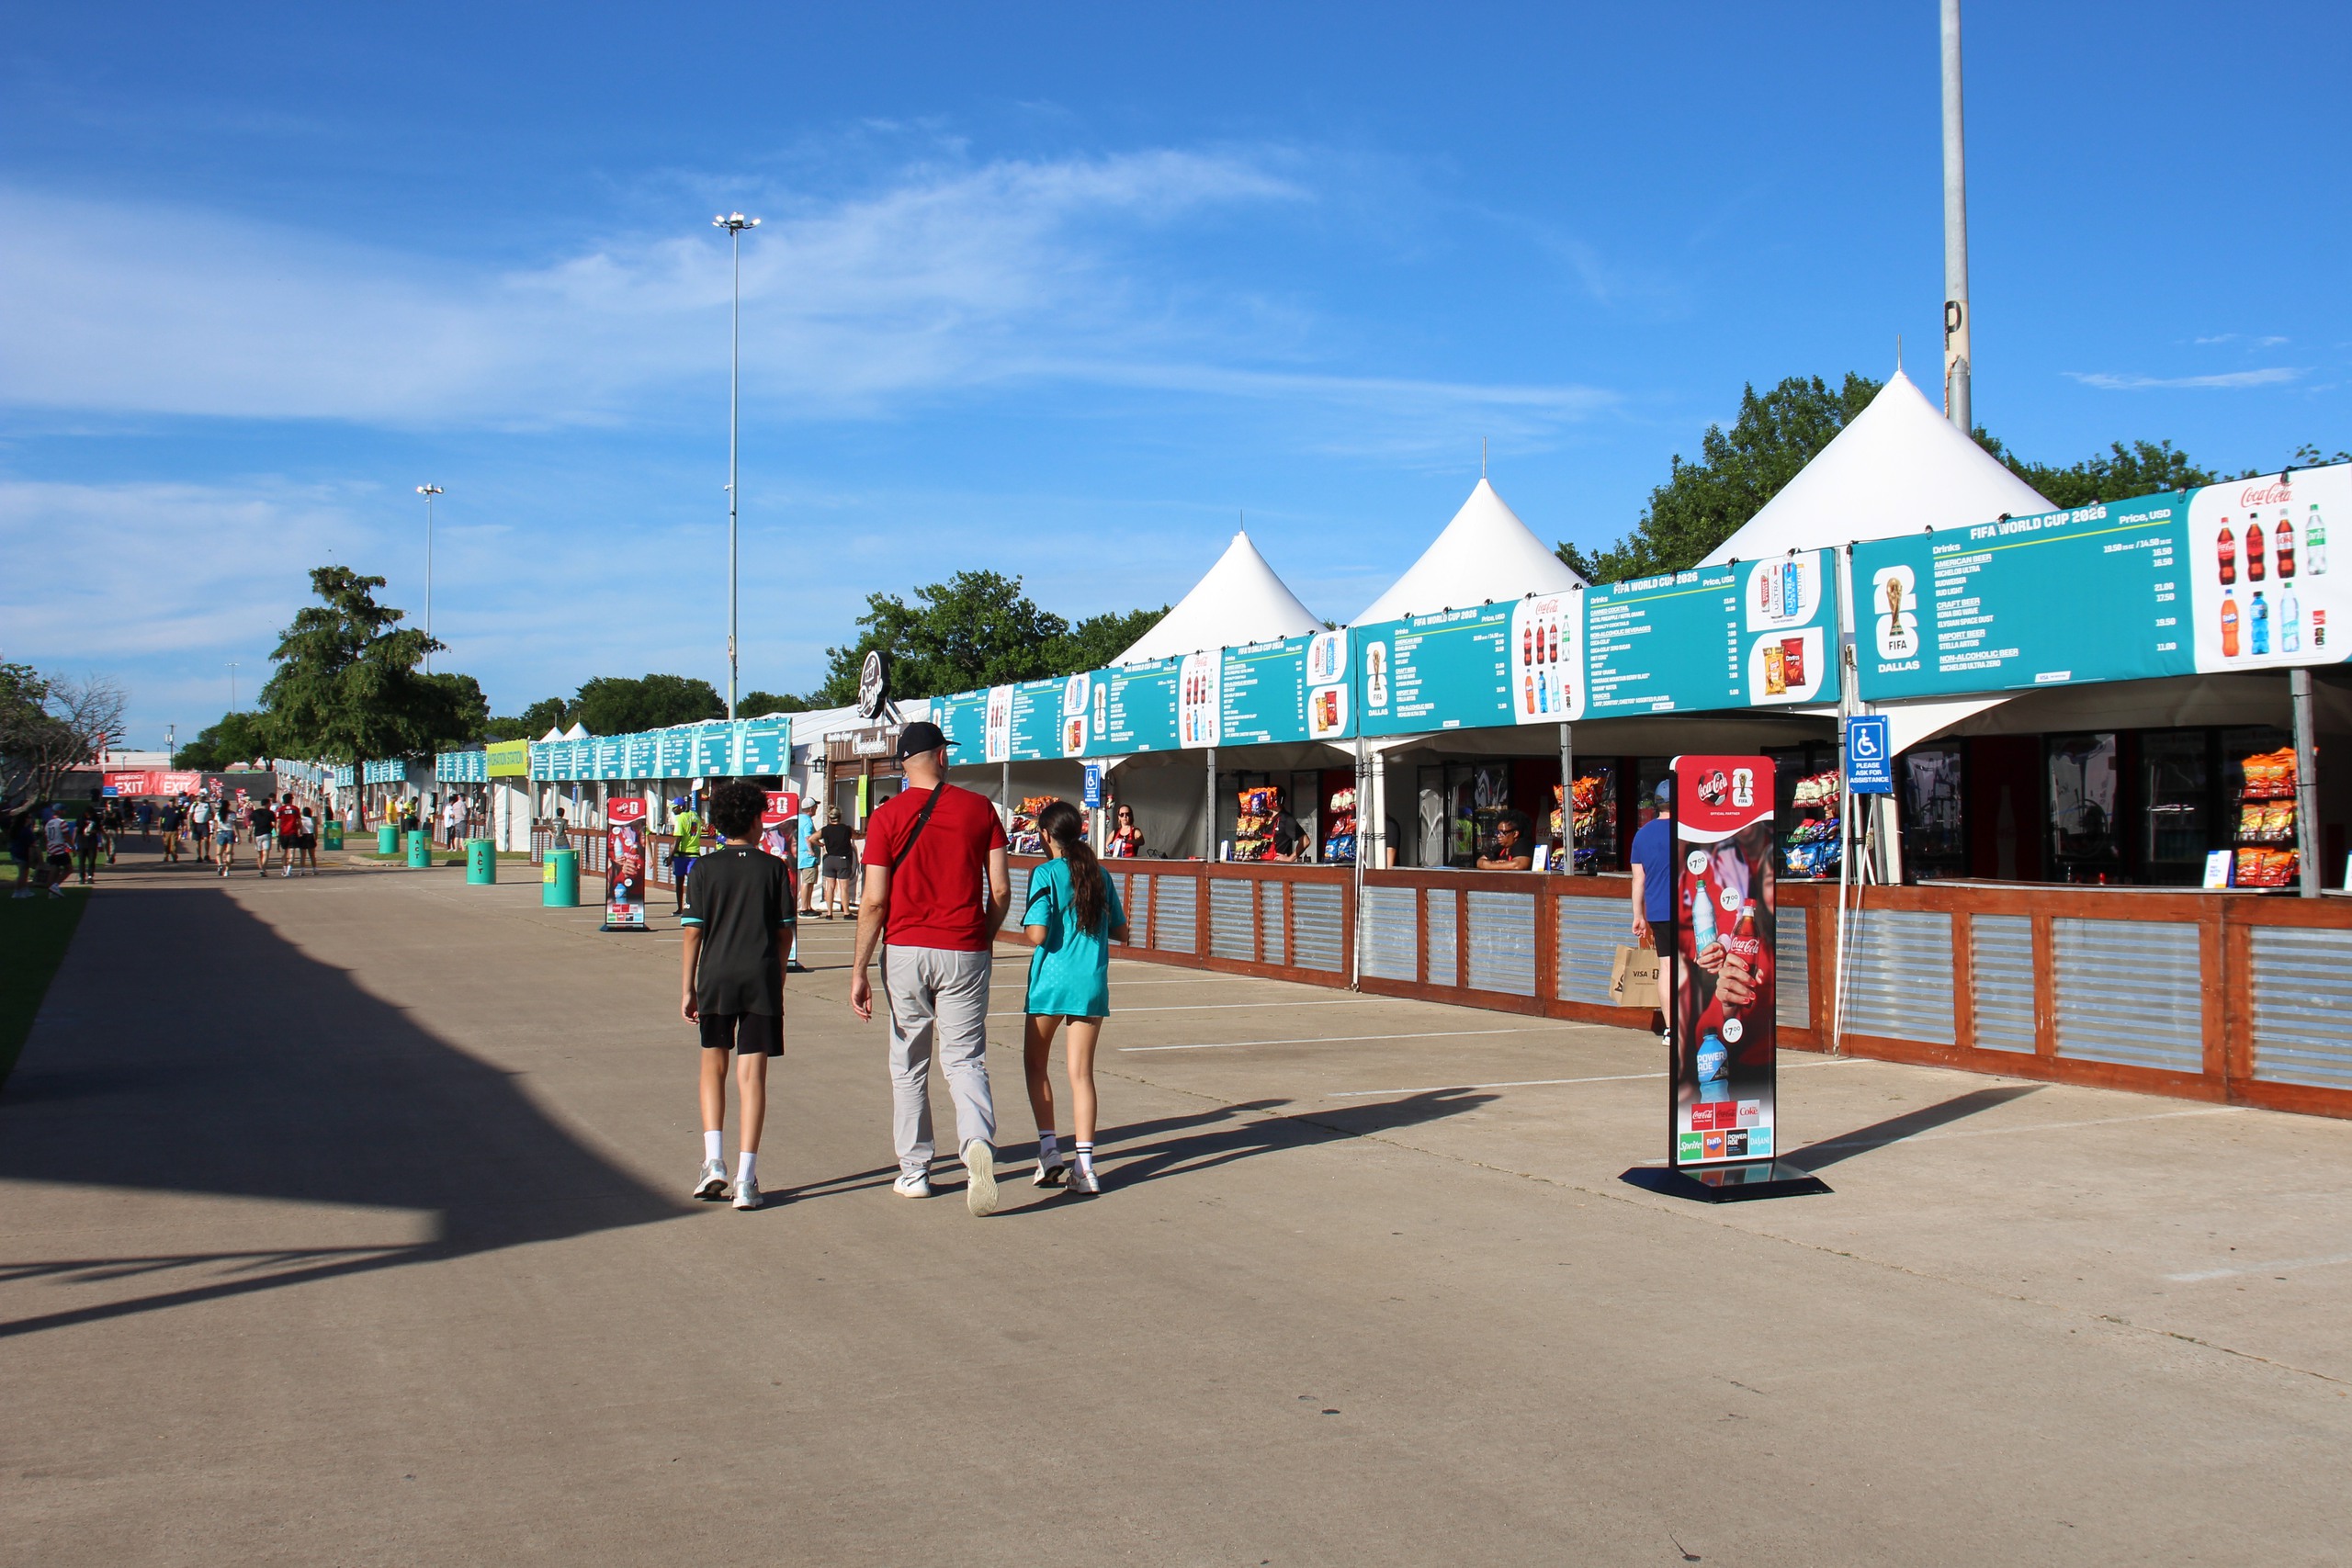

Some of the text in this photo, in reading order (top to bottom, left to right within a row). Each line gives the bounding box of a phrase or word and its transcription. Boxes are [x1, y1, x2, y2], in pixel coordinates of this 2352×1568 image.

[2119, 508, 2171, 525] Price, USD
[1970, 506, 2108, 540] FIFA WORLD CUP 2026
[1933, 543, 1961, 555] Drinks
[2153, 547, 2173, 557] 16.50
[1934, 553, 1992, 569] AMERICAN BEER
[1613, 583, 1630, 595] FIFA
[1631, 578, 1658, 592] WORLD
[1677, 571, 1698, 585] 2026
[1721, 575, 1735, 583] USD
[1590, 596, 1609, 605] Drinks
[1937, 597, 1981, 610] CRAFT BEER
[1413, 616, 1427, 627] FIFA
[1427, 613, 1447, 626] WORLD
[1448, 611, 1460, 623] CUP
[1939, 628, 1985, 641] IMPORT BEER
[1889, 640, 1907, 650] FIFA
[1939, 648, 2019, 664] NON-ALCOHOLIC BEER
[1878, 660, 1920, 673] DALLAS
[115, 782, 144, 794] EXIT
[164, 782, 191, 794] EXIT
[1731, 936, 1759, 954] Coca-Cola
[1633, 970, 1648, 978] VISA
[1697, 1051, 1724, 1064] POWER
[1697, 1062, 1713, 1072] ADE
[1692, 1110, 1713, 1120] Coca-Cola
[1680, 1140, 1702, 1152] Sprite
[1706, 1137, 1723, 1146] FANTA
[1750, 1135, 1770, 1146] DASANI
